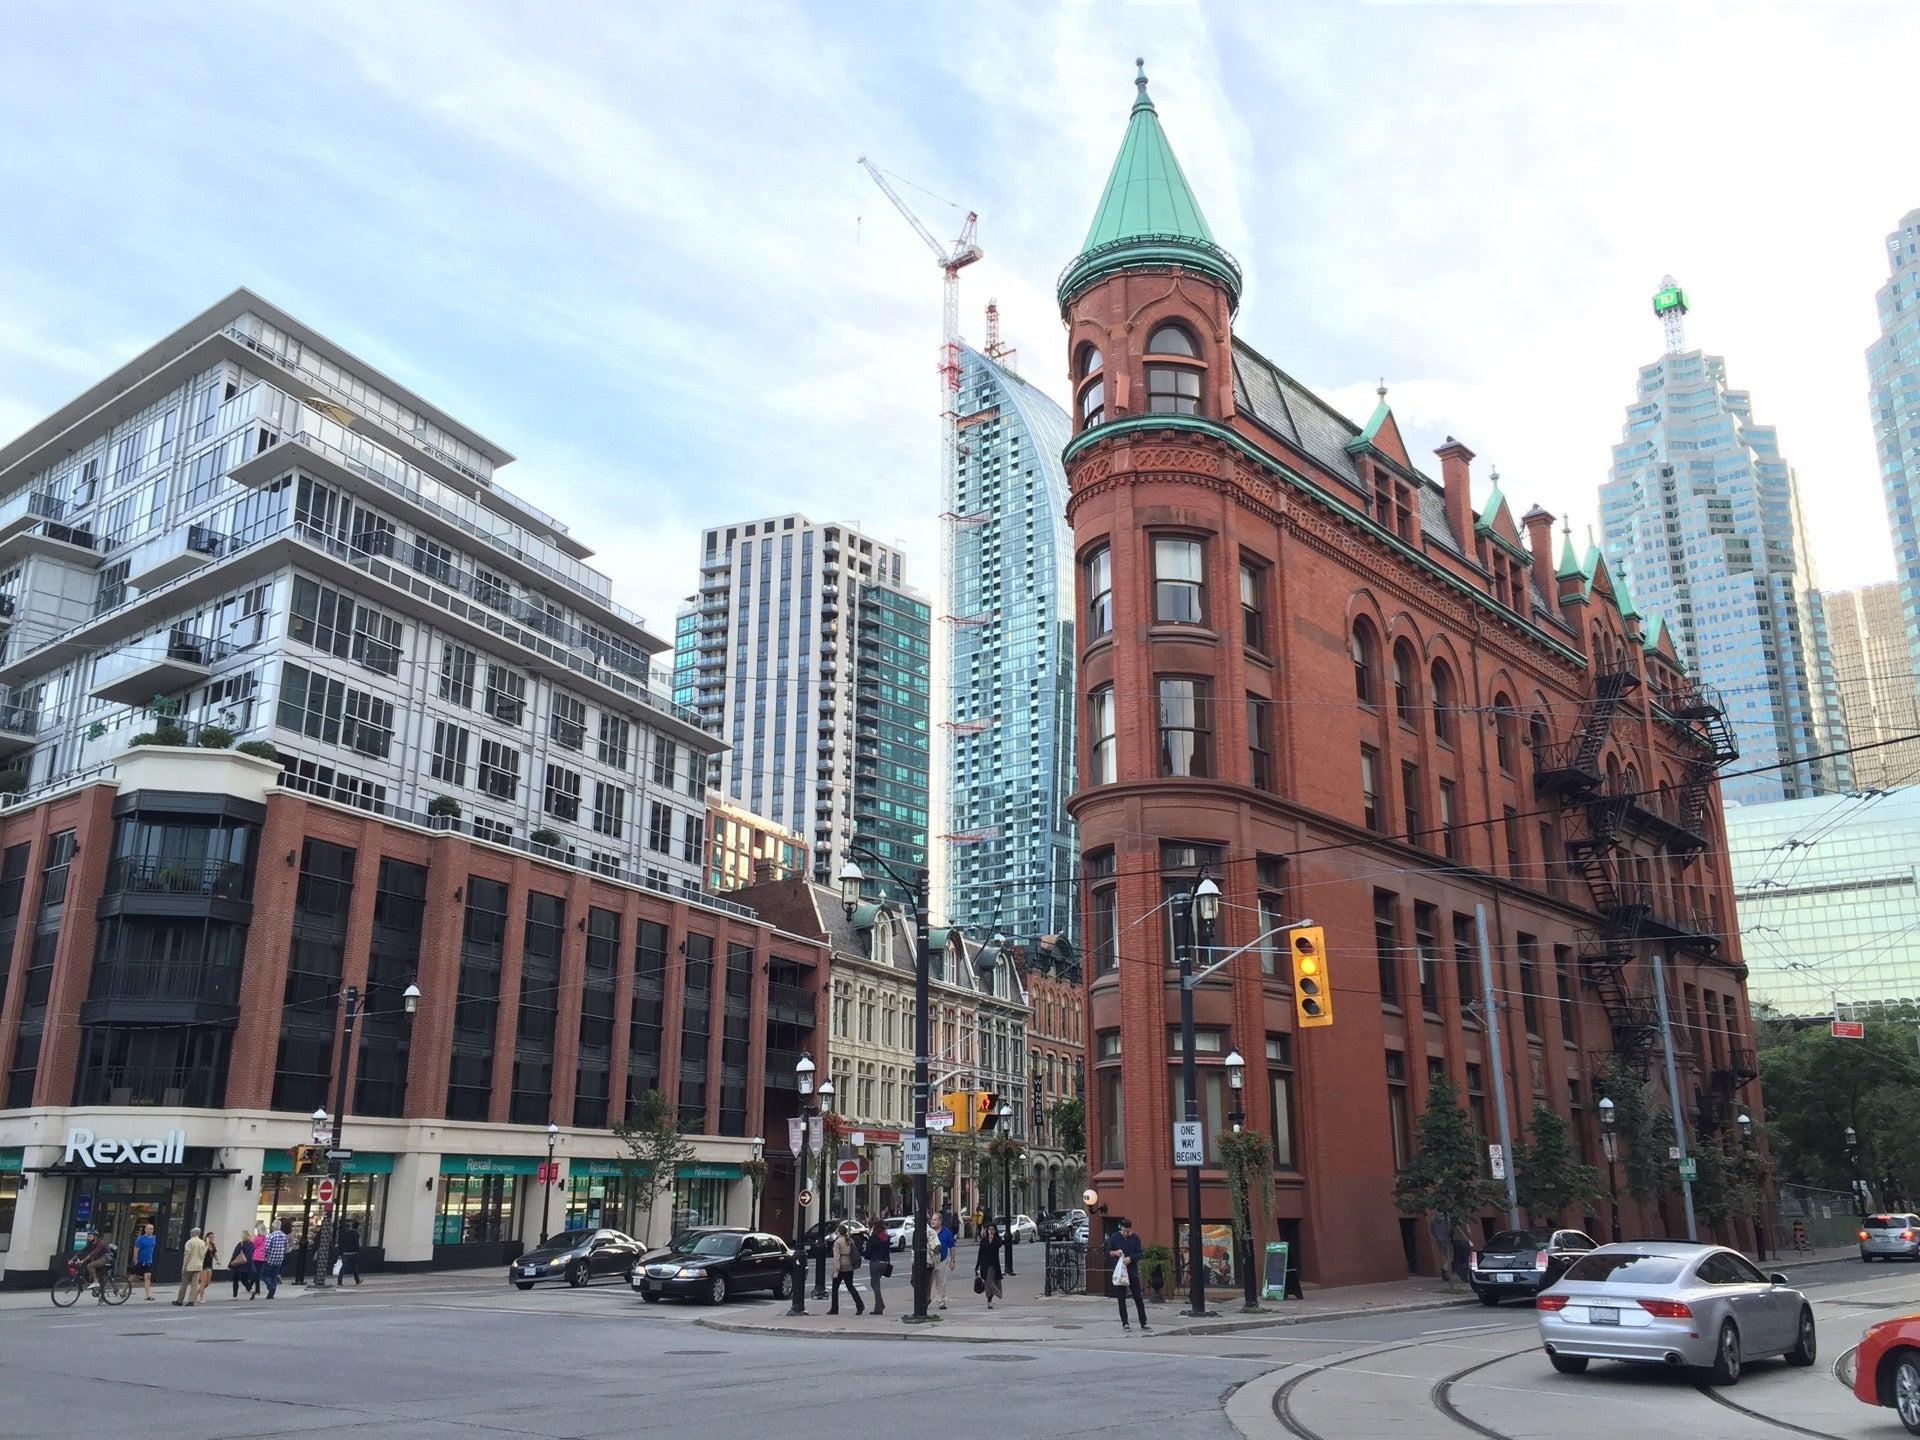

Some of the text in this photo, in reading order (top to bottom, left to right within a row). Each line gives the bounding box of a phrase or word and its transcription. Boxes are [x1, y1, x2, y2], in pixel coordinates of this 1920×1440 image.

[1034, 1079, 1042, 1123] WINNERS
[1180, 1125, 1195, 1136] ONE
[64, 1127, 187, 1168] Rexall
[911, 1141, 921, 1152] NO
[1181, 1139, 1195, 1149] WAY
[1176, 1151, 1202, 1162] BEGINS
[466, 1158, 492, 1171] Rexall
